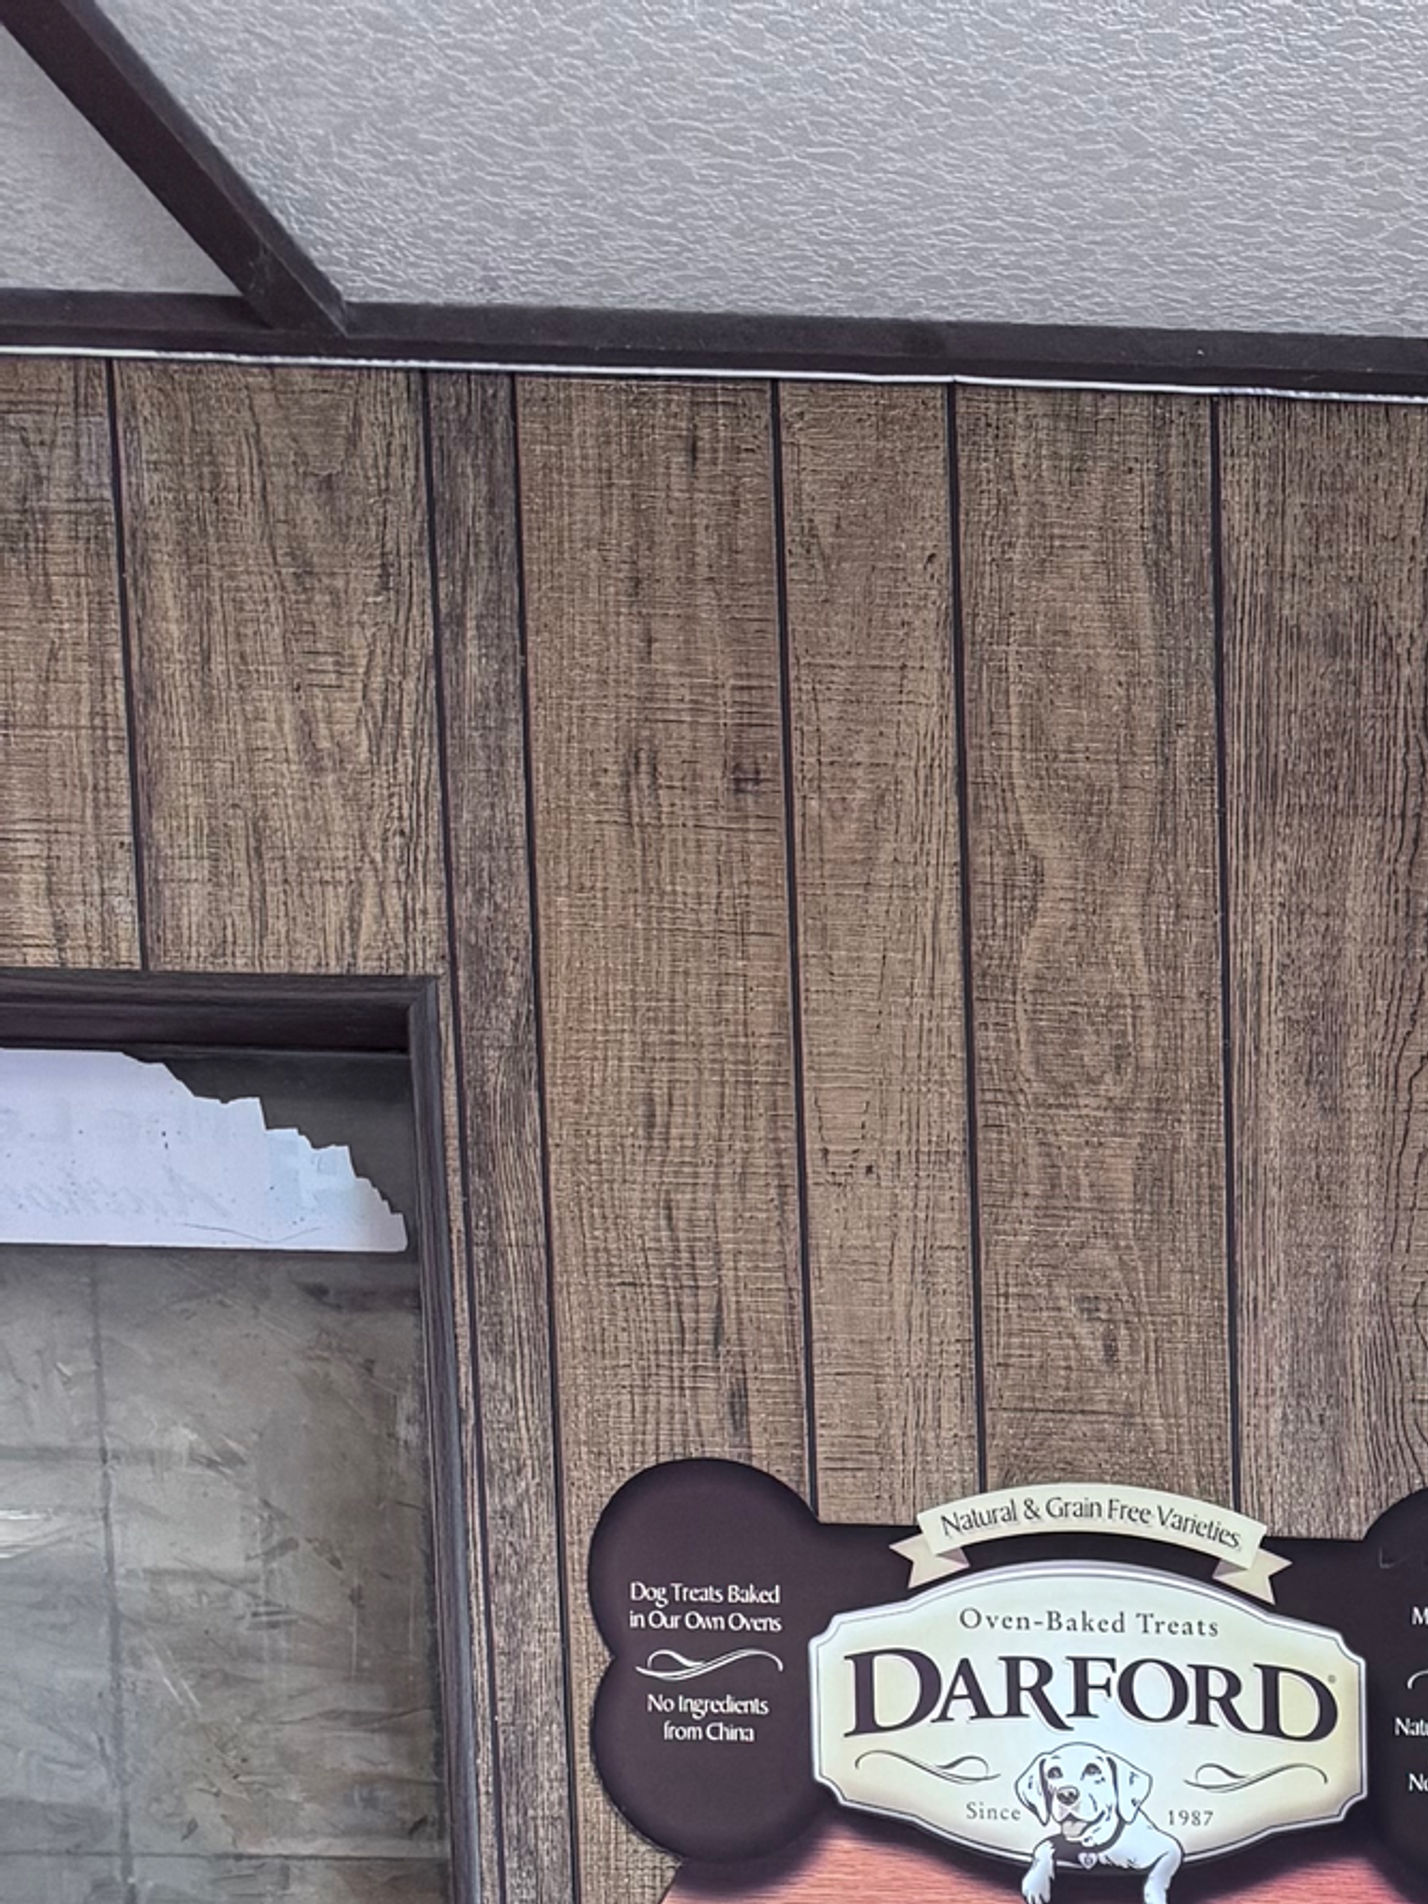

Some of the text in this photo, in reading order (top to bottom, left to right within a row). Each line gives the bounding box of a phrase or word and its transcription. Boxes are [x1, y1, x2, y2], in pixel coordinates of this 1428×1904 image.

[940, 1497, 1240, 1548] Natural & Grain Free Varieties
[631, 1581, 780, 1608] Dog Treats Baked
[630, 1610, 782, 1631] in Our Own Ovens
[959, 1607, 1219, 1636] Oven-Baked Treats
[648, 1694, 769, 1719] No Ingredients
[844, 1648, 1338, 1742] DARFORD
[664, 1721, 753, 1741] from China
[966, 1801, 1213, 1827] Since 1987
